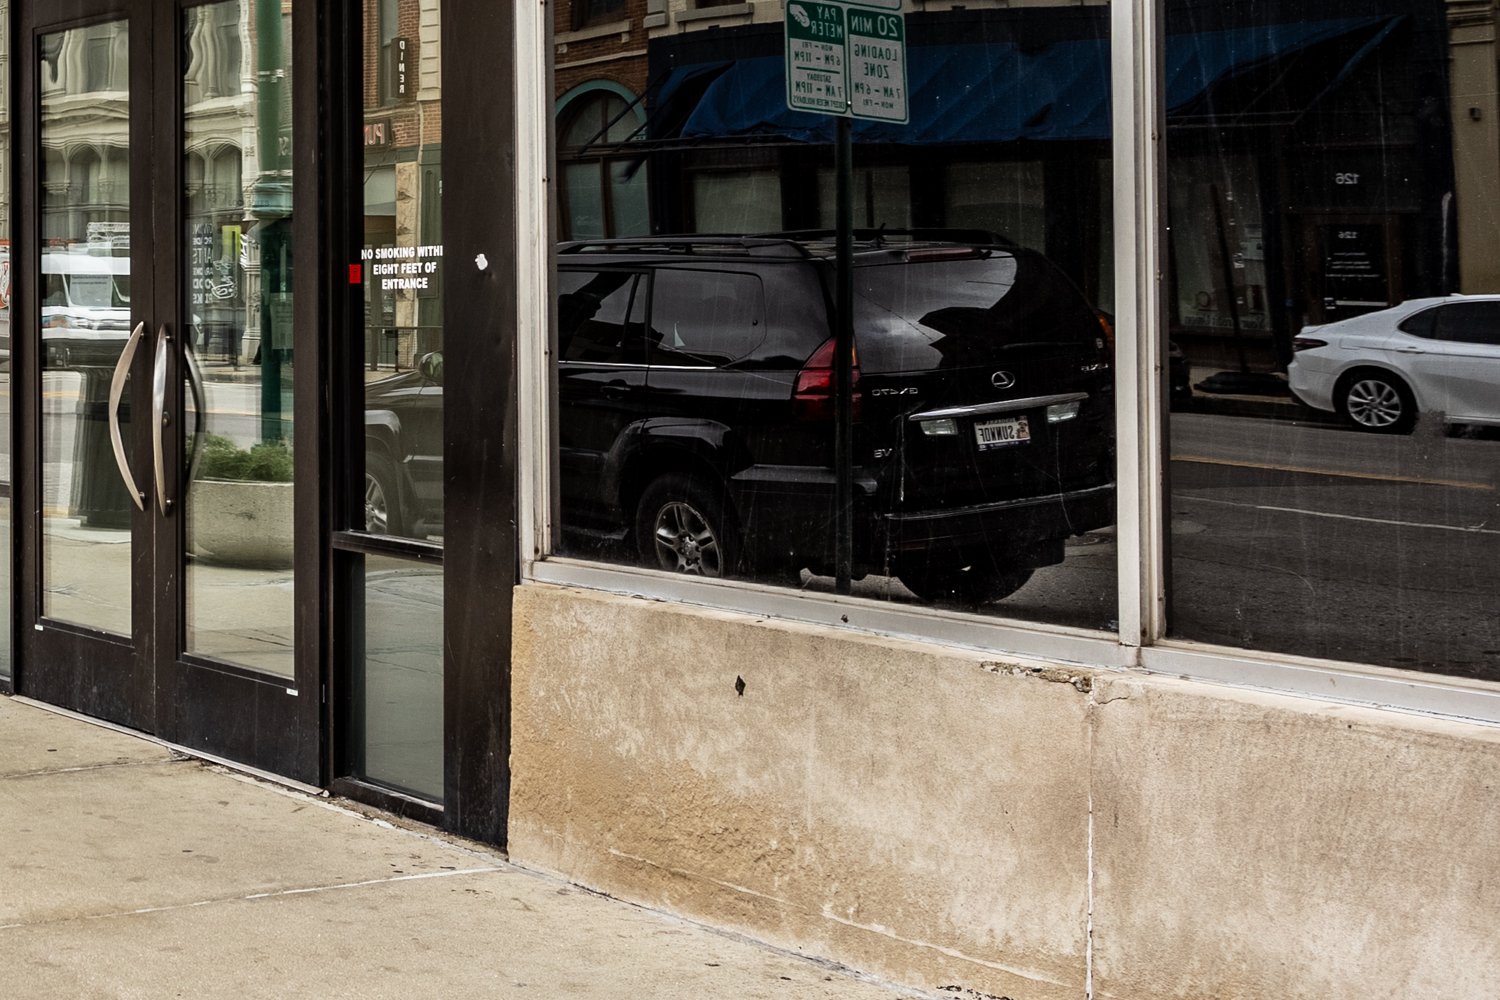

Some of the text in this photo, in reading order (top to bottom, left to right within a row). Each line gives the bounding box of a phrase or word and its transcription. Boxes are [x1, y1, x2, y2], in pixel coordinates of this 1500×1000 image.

[361, 245, 444, 260] NO SMOKING WITHI
[373, 263, 400, 275] EIGHT
[401, 262, 423, 274] FEET
[424, 262, 437, 274] OF
[382, 278, 428, 290] ENTRANCE
